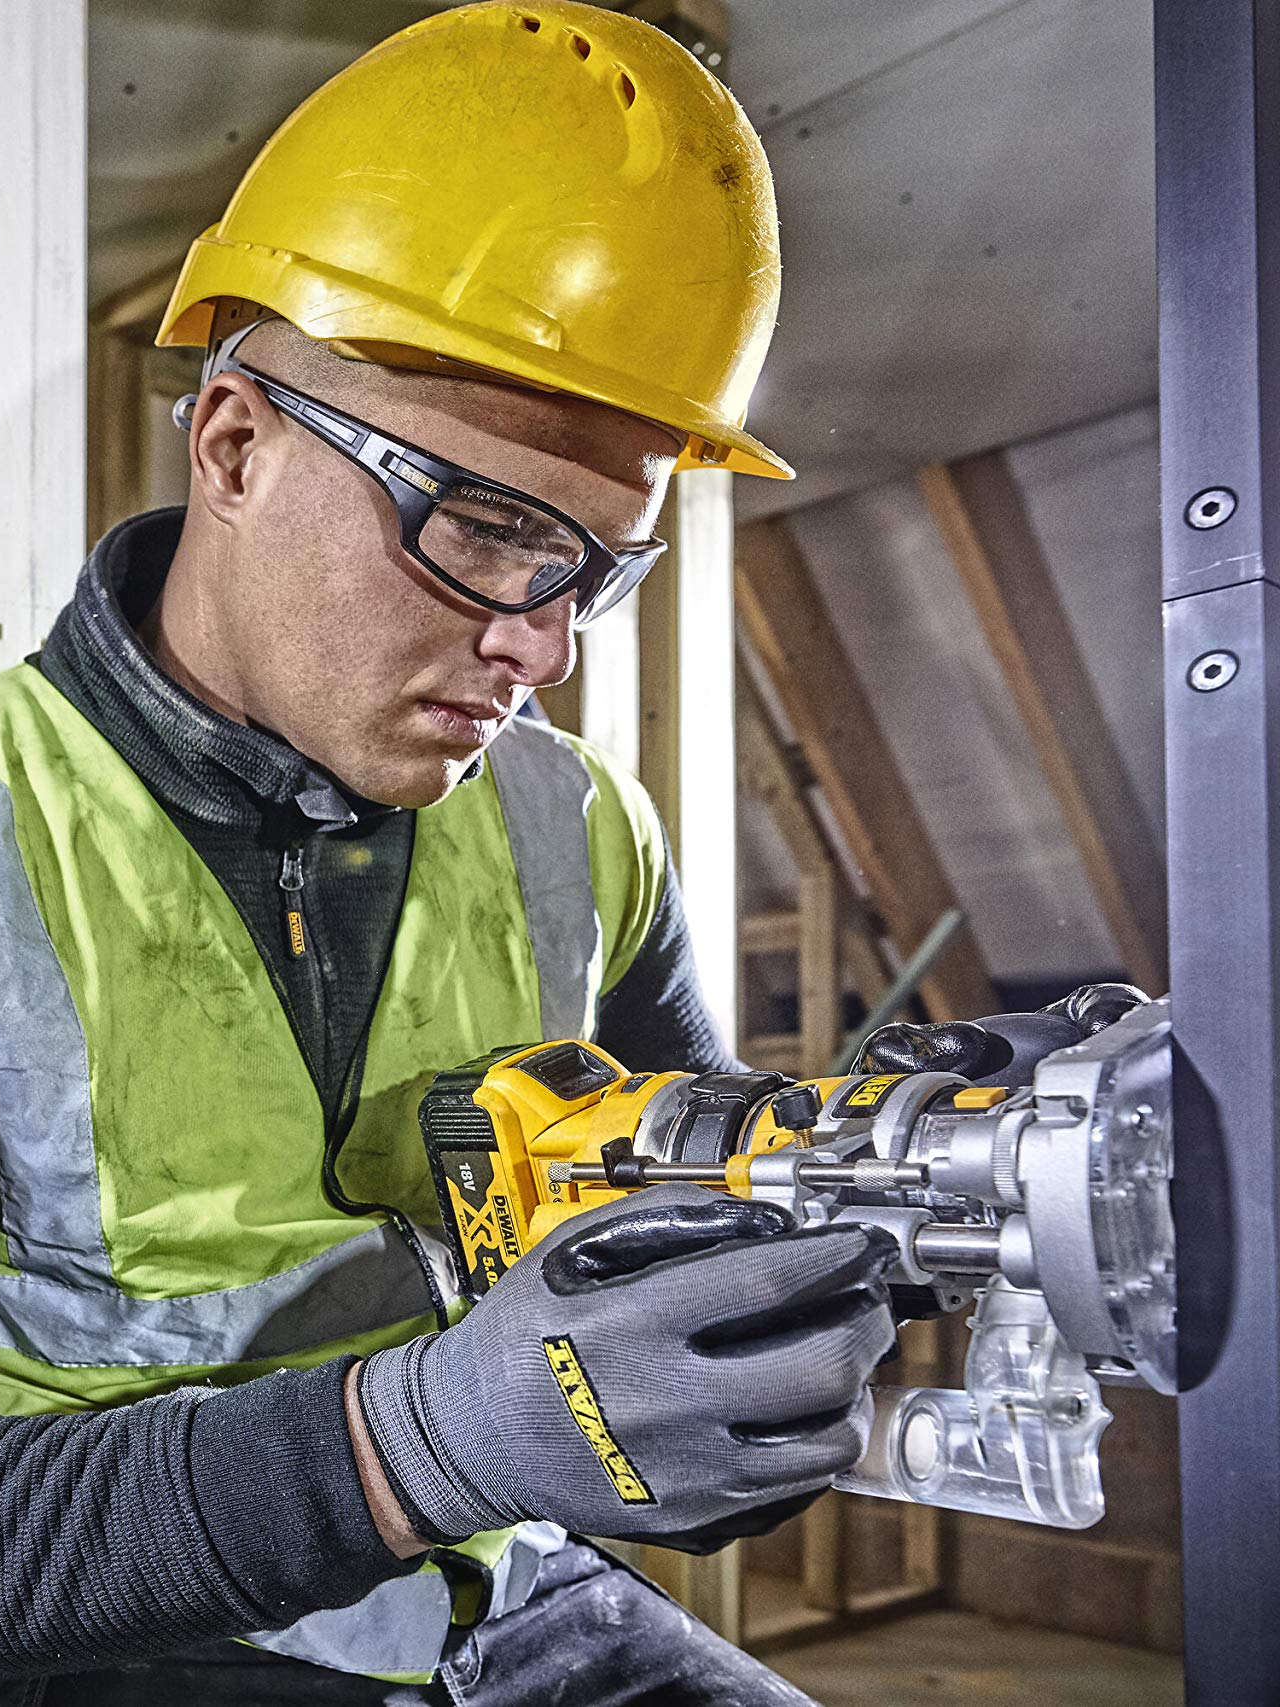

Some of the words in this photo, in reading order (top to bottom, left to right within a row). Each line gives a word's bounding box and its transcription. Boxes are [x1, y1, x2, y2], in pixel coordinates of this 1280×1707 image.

[459, 1162, 476, 1192] 18V
[493, 1195, 520, 1257] DEWALT
[546, 1340, 648, 1500] DEWALT
